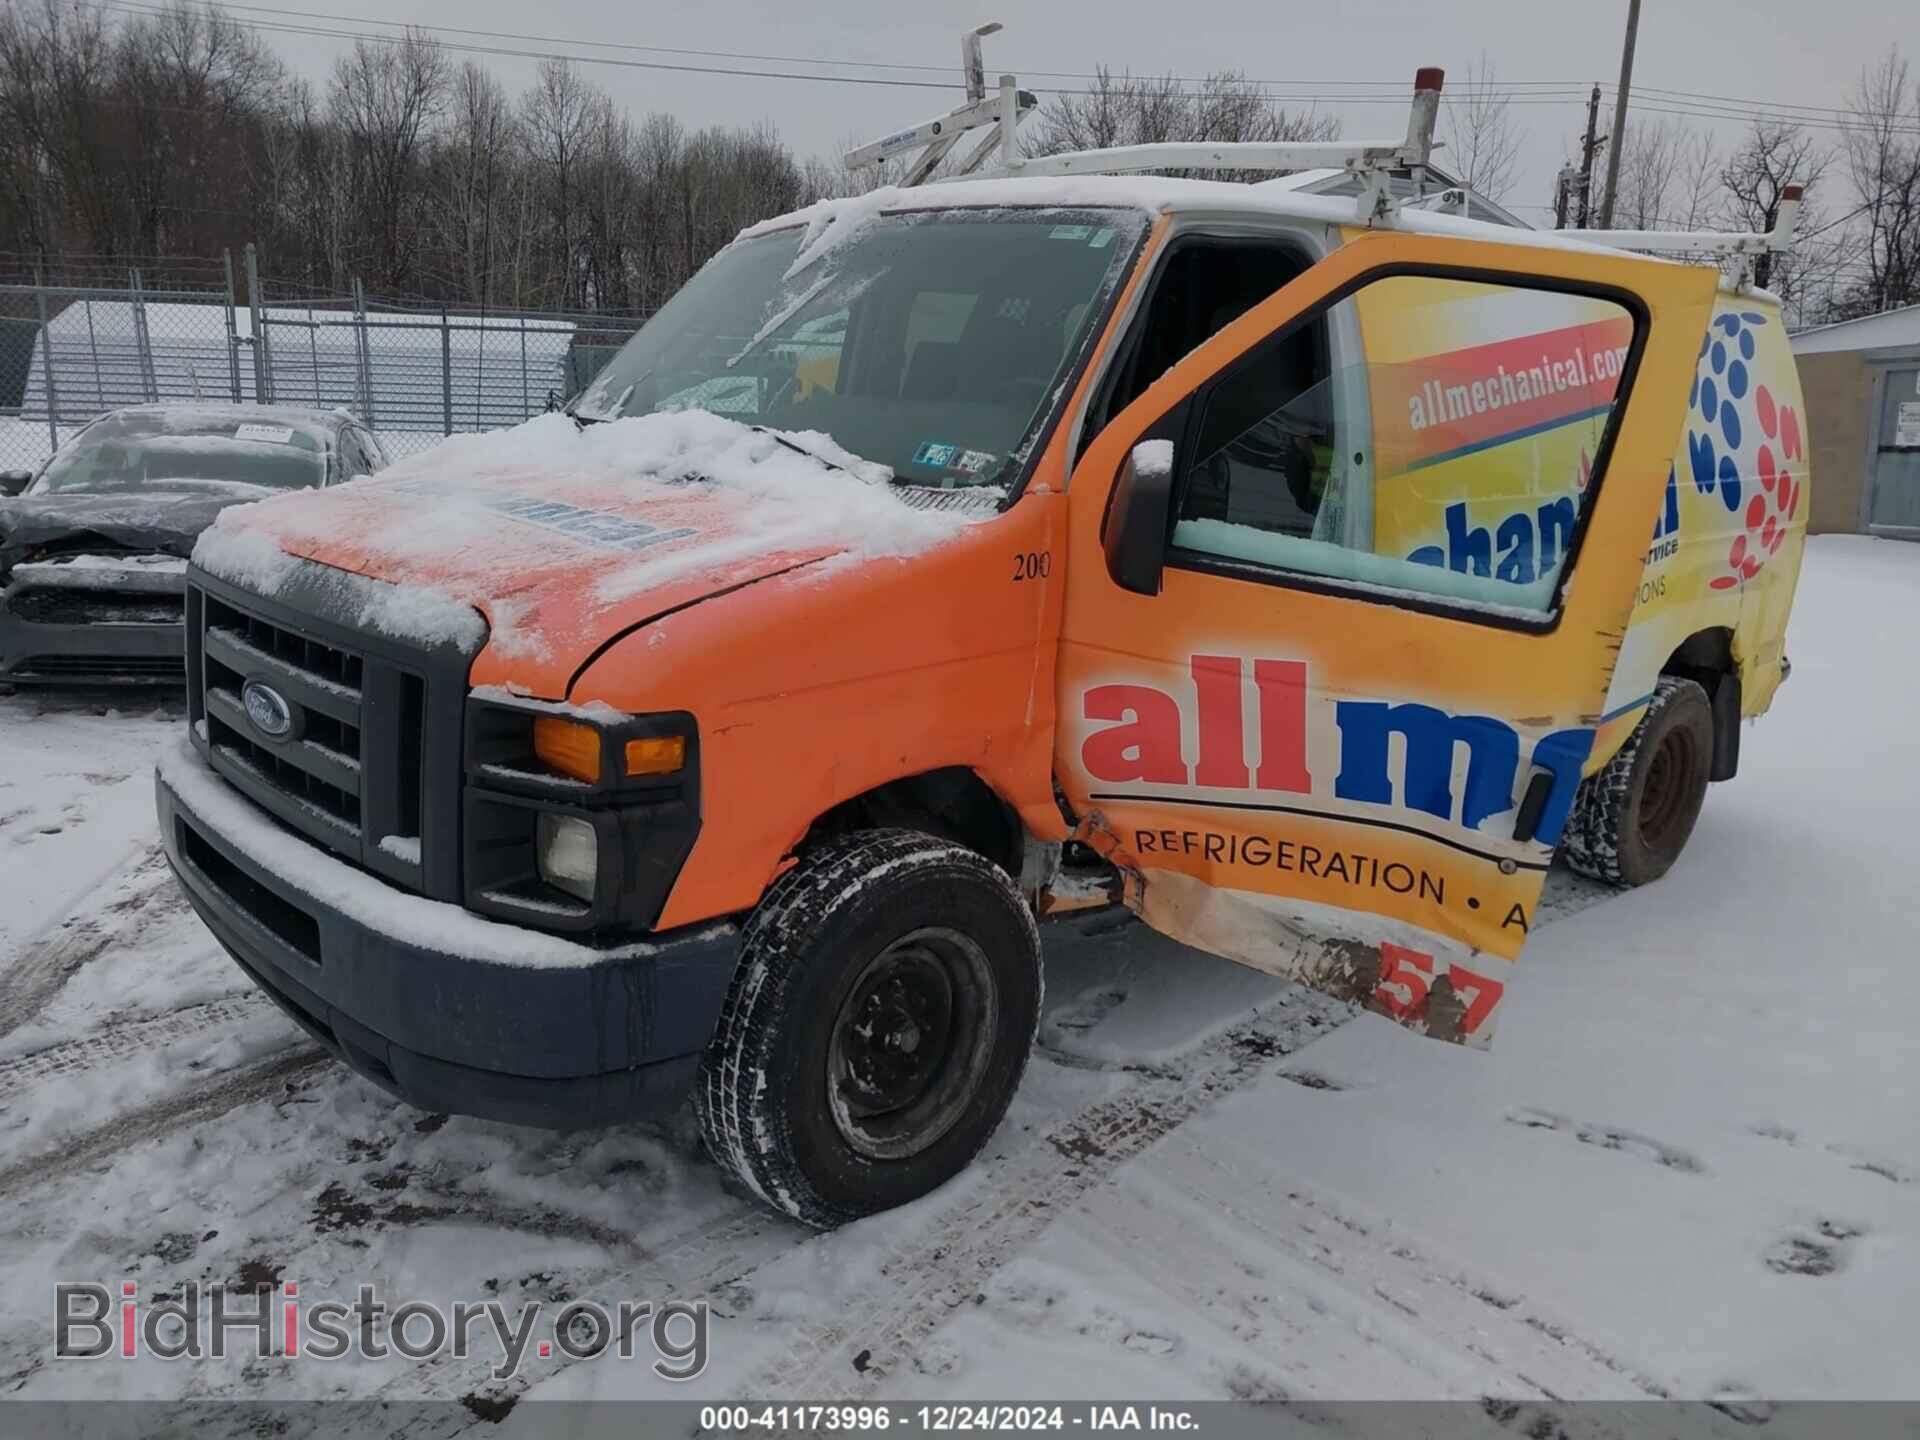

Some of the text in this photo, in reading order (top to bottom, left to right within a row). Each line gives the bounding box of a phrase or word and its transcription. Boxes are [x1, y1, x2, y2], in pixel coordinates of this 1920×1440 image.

[1636, 575, 1666, 606] IONS
[1081, 654, 1312, 794] all
[1136, 830, 1445, 905] REFRIGERATION
